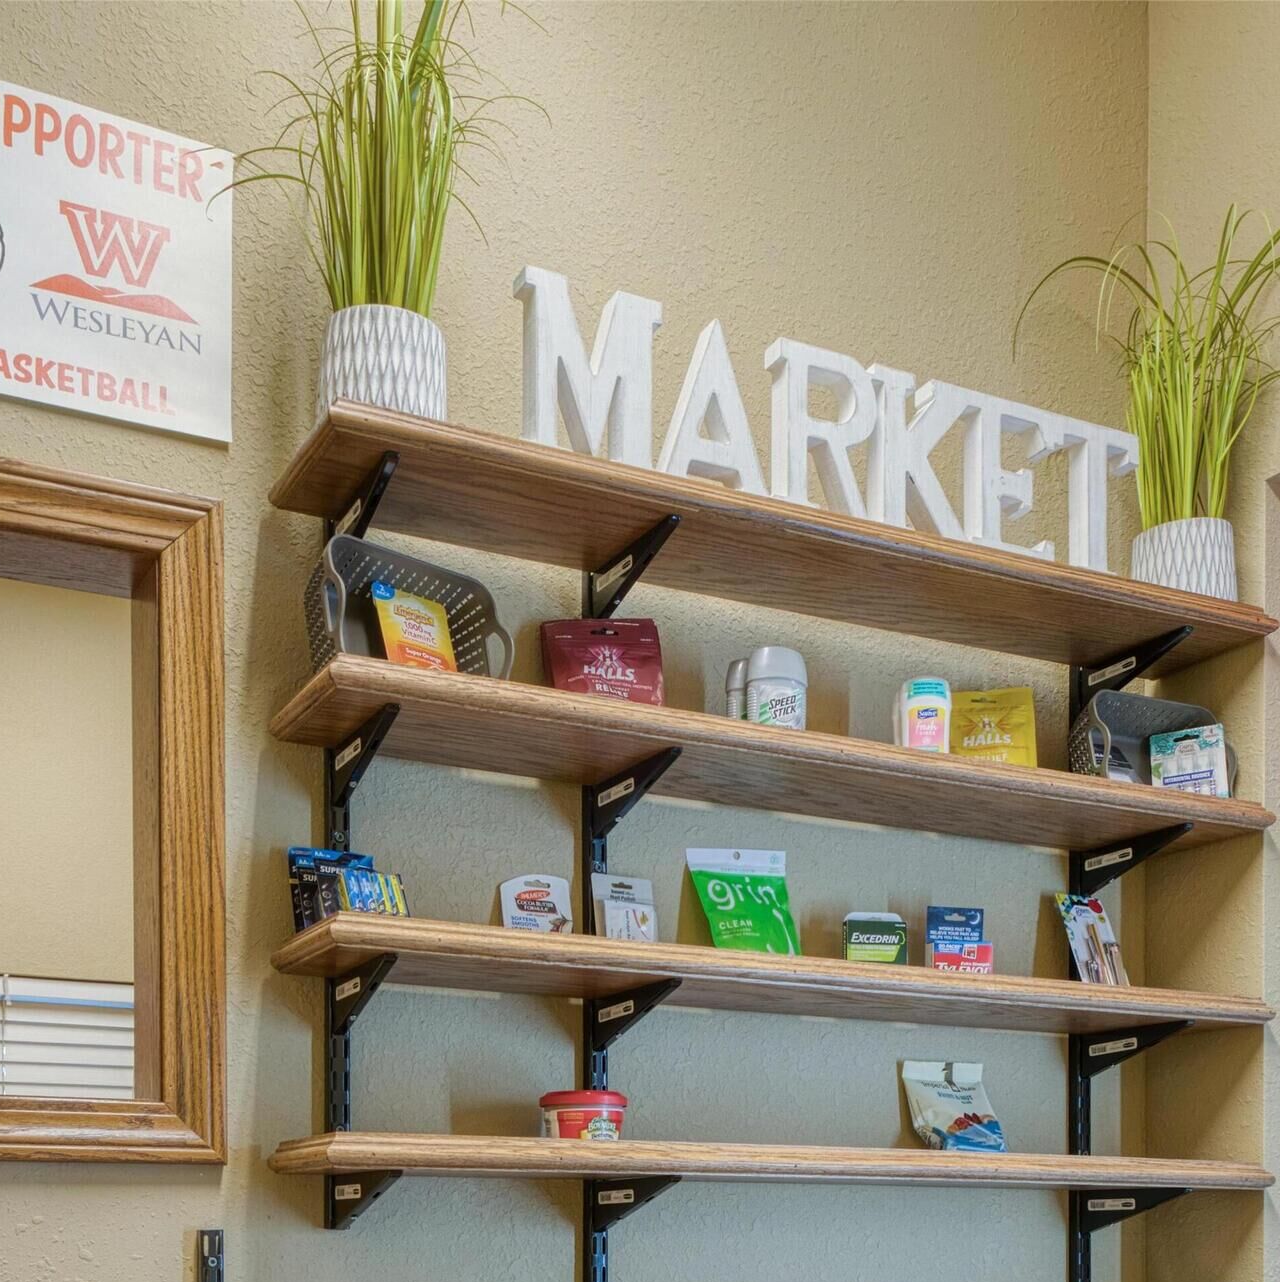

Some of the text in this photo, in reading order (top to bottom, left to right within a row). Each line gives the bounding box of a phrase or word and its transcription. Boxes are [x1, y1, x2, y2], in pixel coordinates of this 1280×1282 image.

[59, 200, 170, 287] W
[29, 292, 202, 355] WESLEYAN
[513, 266, 1139, 572] MARKET
[584, 665, 635, 681] HALLS
[769, 695, 796, 710] SPEED
[772, 705, 796, 719] STICK
[963, 734, 1011, 747] HALLS
[707, 877, 786, 910] grin
[719, 920, 752, 929] CLEAN
[851, 932, 900, 944] EXCEDRIN
